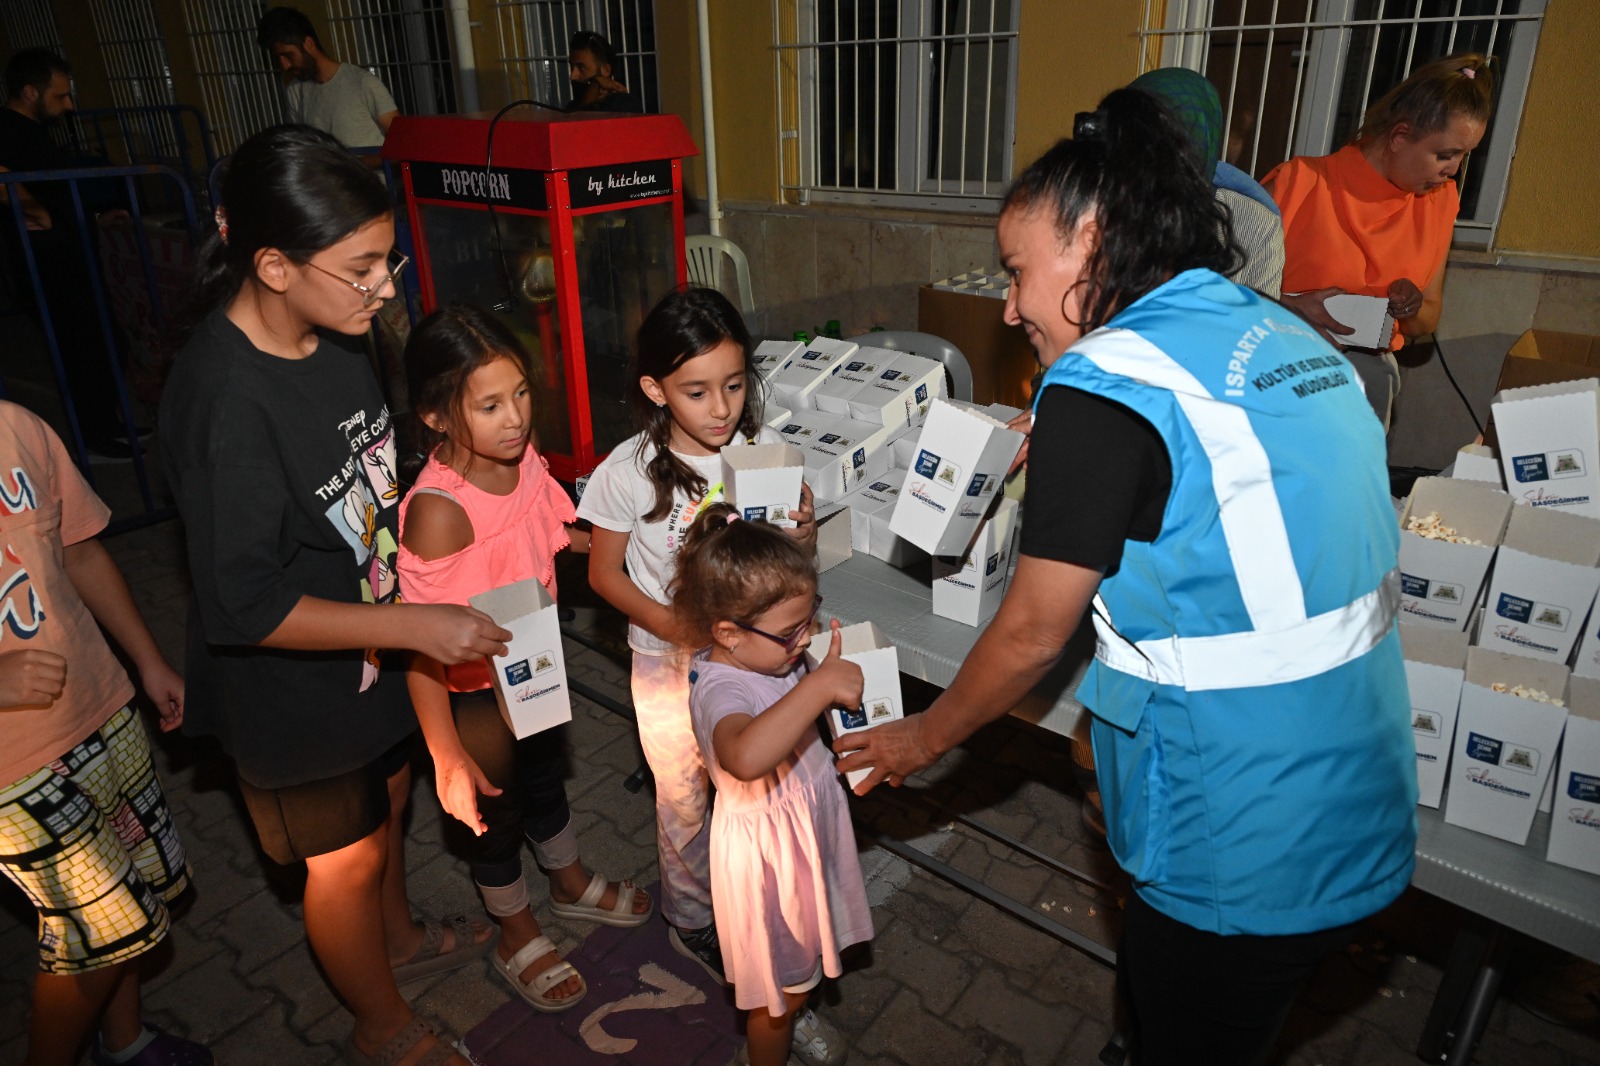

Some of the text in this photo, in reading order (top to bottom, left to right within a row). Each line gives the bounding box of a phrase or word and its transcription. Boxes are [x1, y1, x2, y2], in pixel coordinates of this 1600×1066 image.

[441, 169, 511, 200] POPCORN
[588, 171, 656, 195] by kitchen
[1225, 325, 1270, 397] ISPARTA
[1252, 363, 1301, 392] KÜLTÜR
[315, 475, 344, 500] THE
[350, 429, 371, 452] EYE
[668, 503, 683, 531] WHERE
[667, 536, 674, 549] GO
